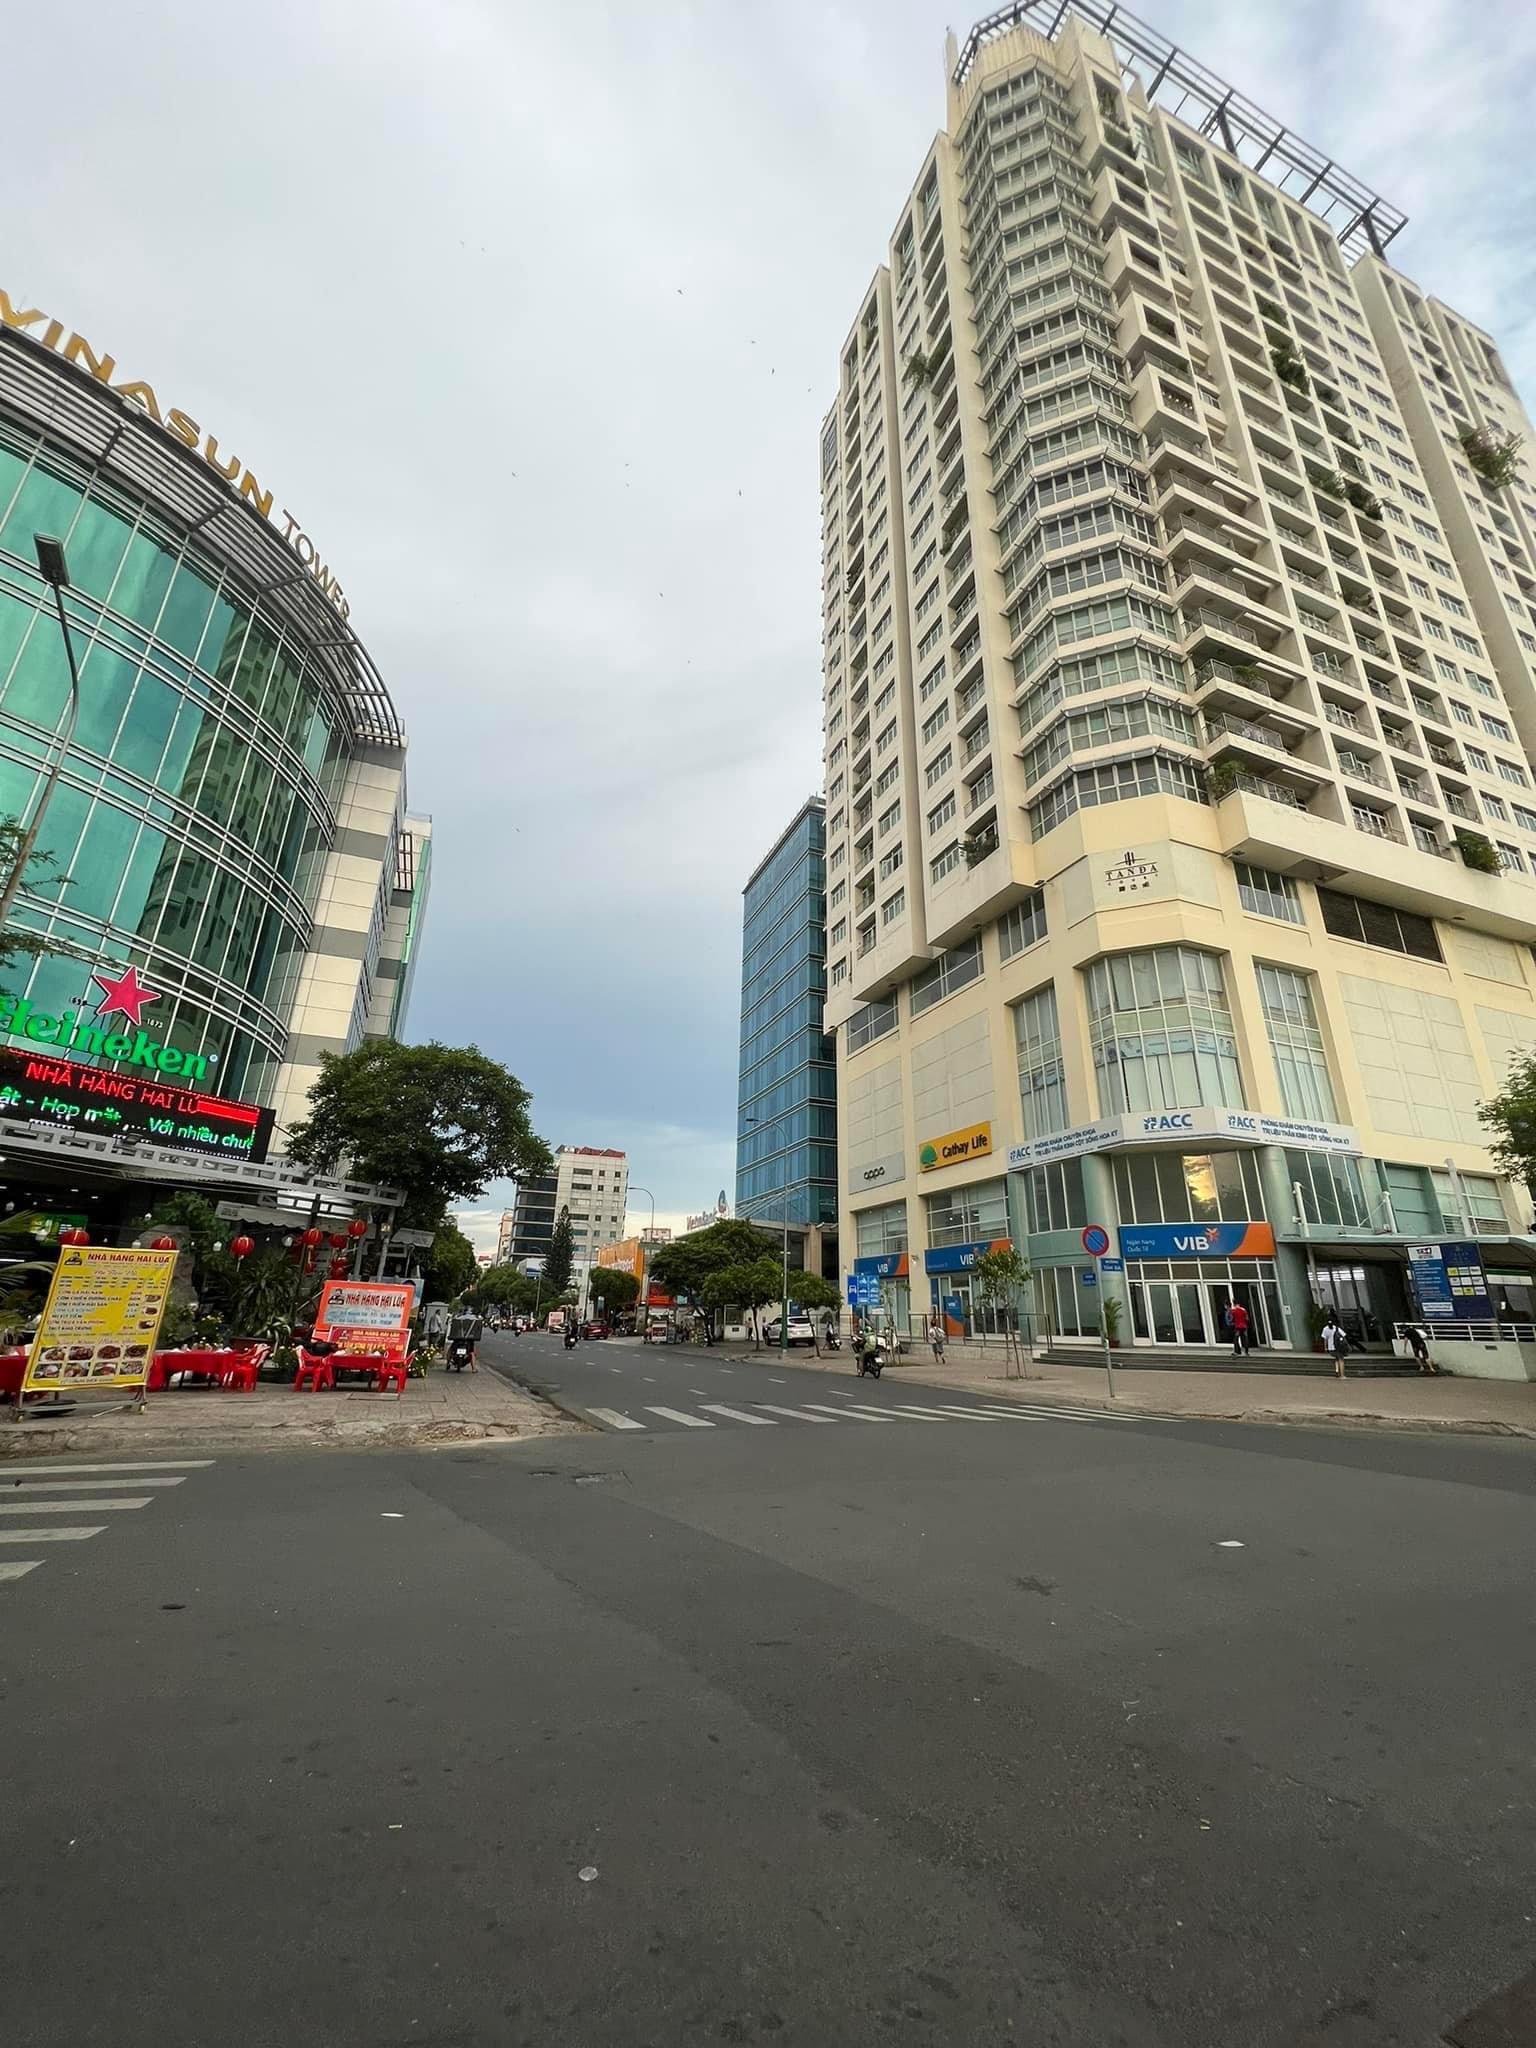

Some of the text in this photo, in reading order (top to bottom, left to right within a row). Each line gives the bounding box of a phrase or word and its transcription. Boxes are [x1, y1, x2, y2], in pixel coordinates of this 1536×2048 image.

[0, 288, 351, 622] VINASUN TOWER
[1105, 863, 1158, 881] TANDA
[0, 995, 208, 1080] Heineken
[79, 1071, 137, 1100] HÀNG
[140, 1087, 174, 1109] HAI
[1160, 1113, 1193, 1129] ACC
[1237, 1116, 1256, 1129] ACC
[942, 1134, 988, 1159] Cathay Life
[1017, 1145, 1031, 1158] ACC
[1174, 1236, 1210, 1251] VIB
[136, 1255, 153, 1263] HAI
[960, 1253, 975, 1266] VIB
[877, 1263, 889, 1273] VIB
